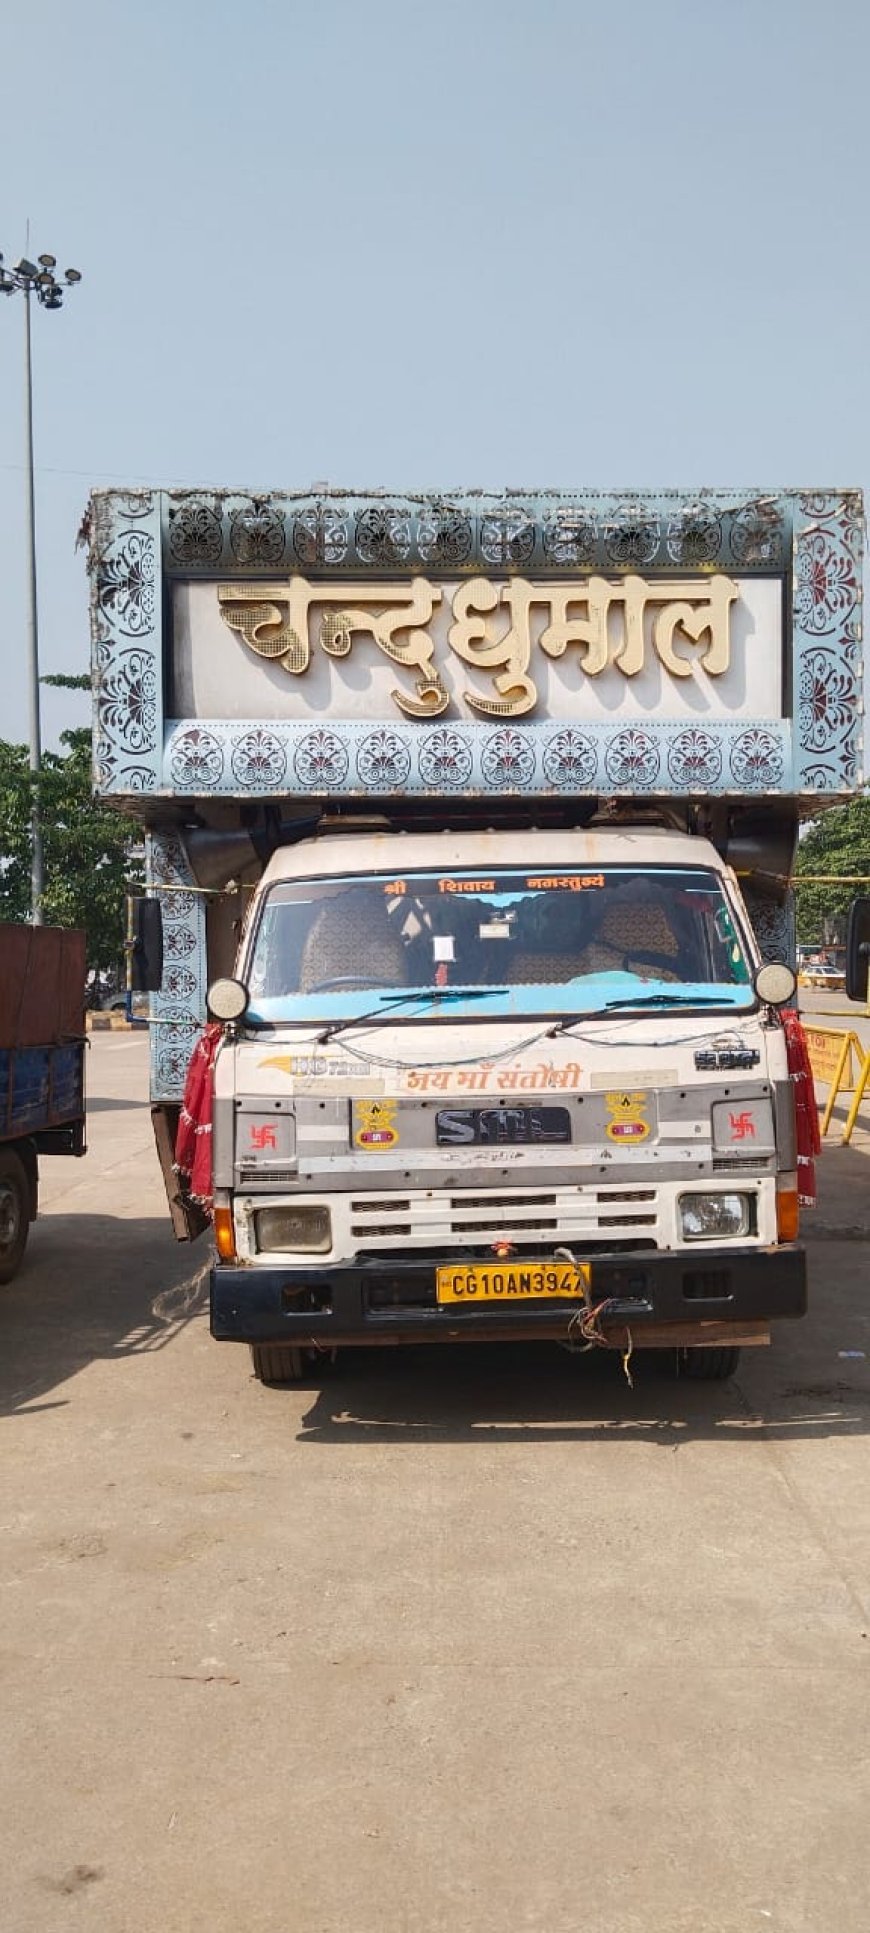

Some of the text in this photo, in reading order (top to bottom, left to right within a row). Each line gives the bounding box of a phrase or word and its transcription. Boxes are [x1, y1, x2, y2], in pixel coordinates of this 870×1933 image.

[217, 576, 740, 718] चन्दु धुमाल
[384, 879, 406, 895] श्री
[439, 878, 496, 893] शिवाय
[407, 1071, 452, 1091] जय
[497, 1062, 583, 1089] संतोषी
